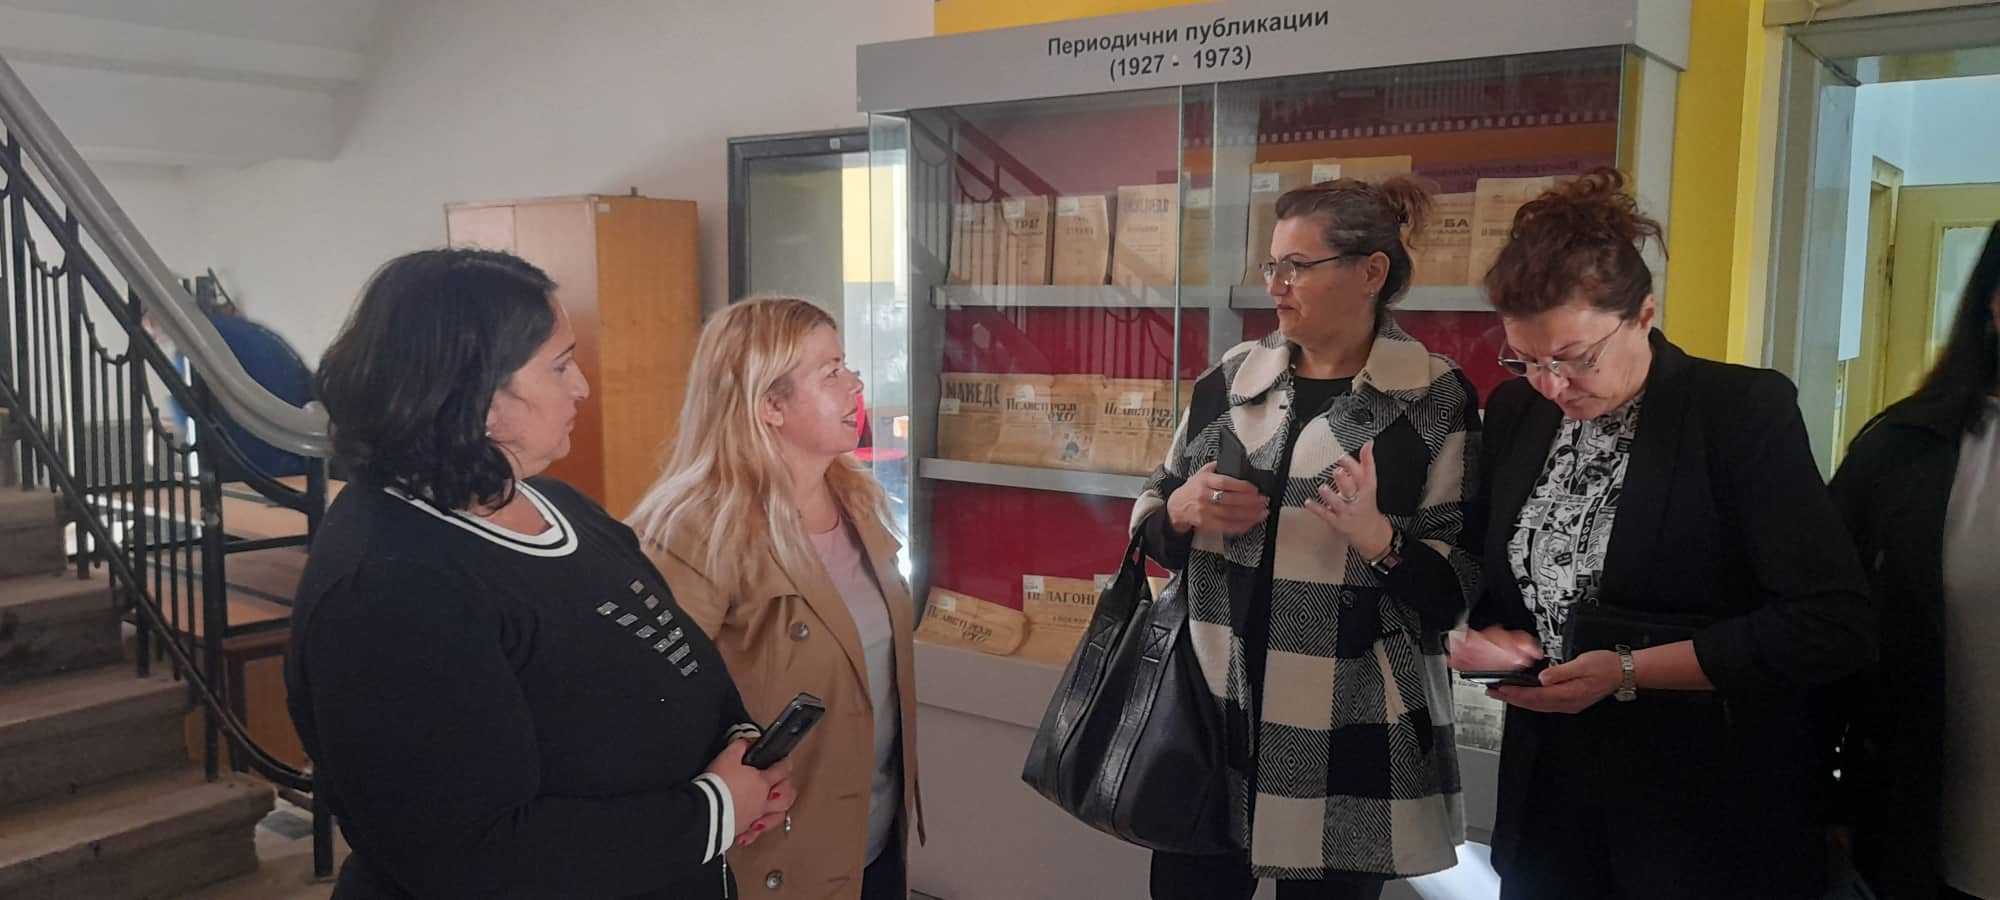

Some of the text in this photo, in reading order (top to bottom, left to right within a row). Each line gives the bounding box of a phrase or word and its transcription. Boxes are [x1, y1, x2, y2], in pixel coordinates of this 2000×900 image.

[1048, 10, 1329, 57] Периодични публикации
[1109, 54, 1165, 82] (1927
[1193, 45, 1252, 71] 1973)
